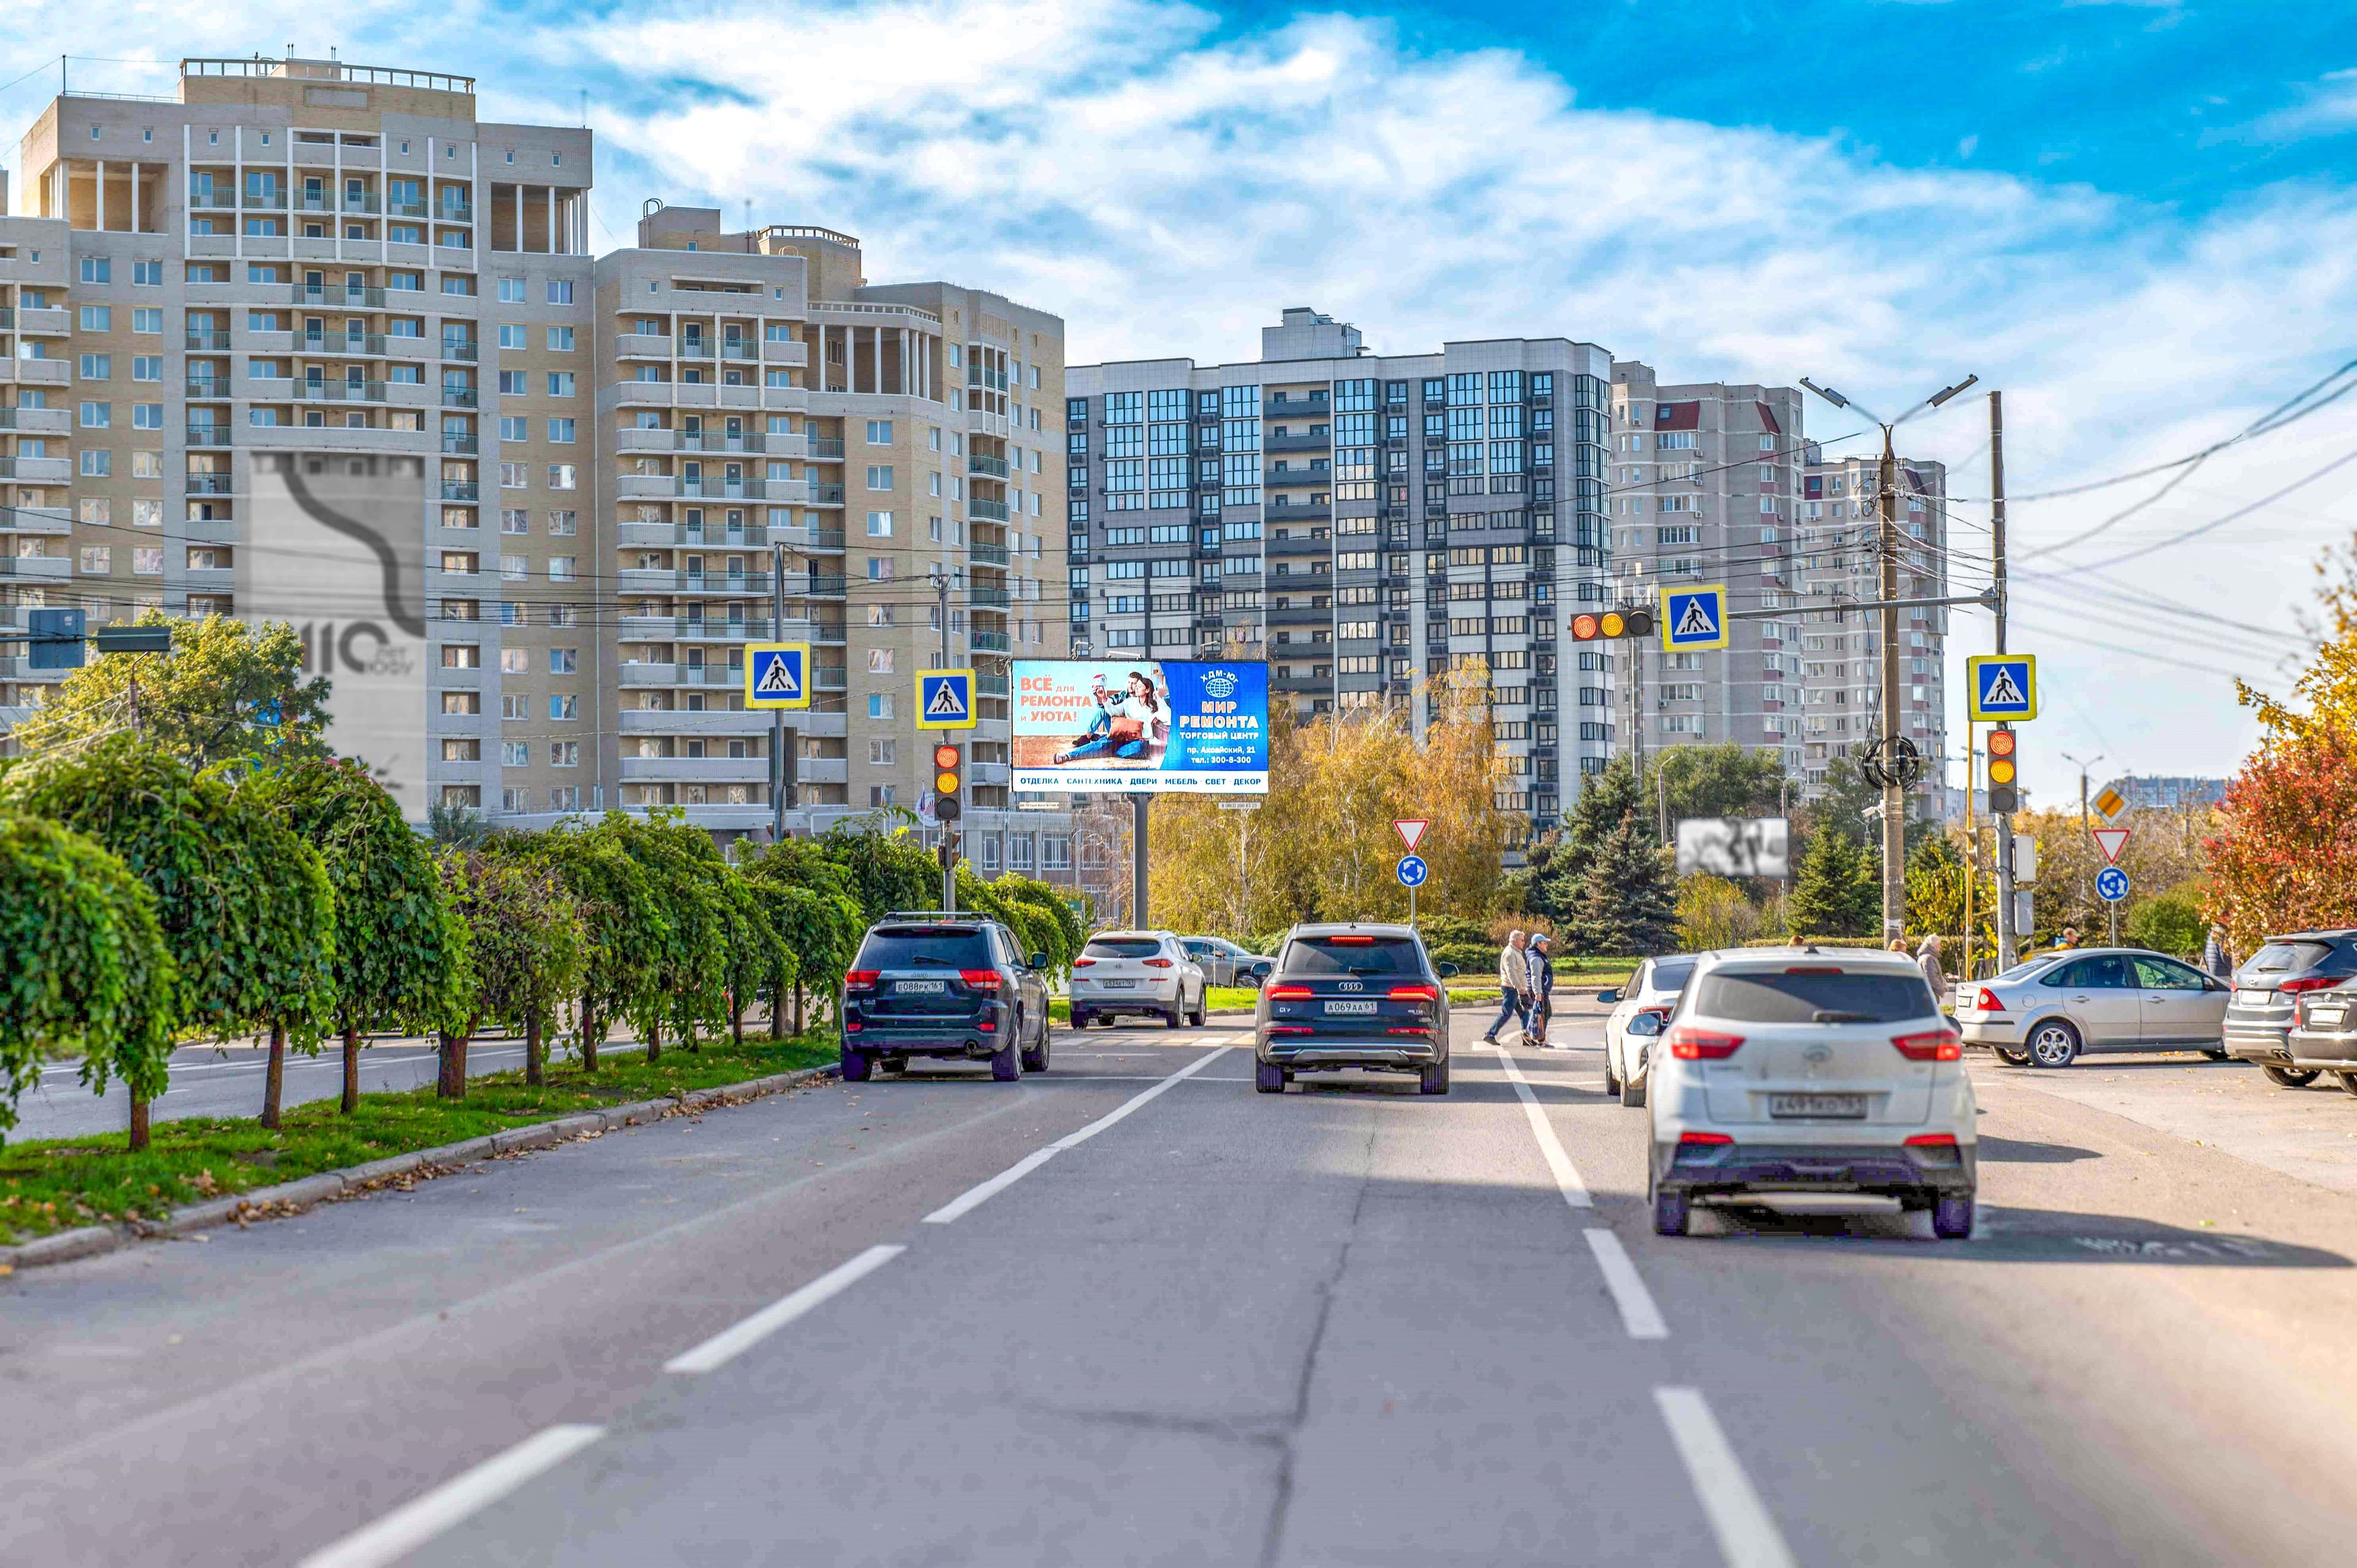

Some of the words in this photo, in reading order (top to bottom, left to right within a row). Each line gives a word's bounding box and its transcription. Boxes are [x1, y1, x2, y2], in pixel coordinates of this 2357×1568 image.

[1021, 674, 1053, 692] ВСЁ
[1021, 695, 1092, 707] РЕМОНТА
[1201, 701, 1237, 713] МИР
[1031, 711, 1077, 722] УЮТА!
[1180, 716, 1259, 728] РЕМОНТА
[1180, 731, 1228, 740] ТОРГОВЫЙ
